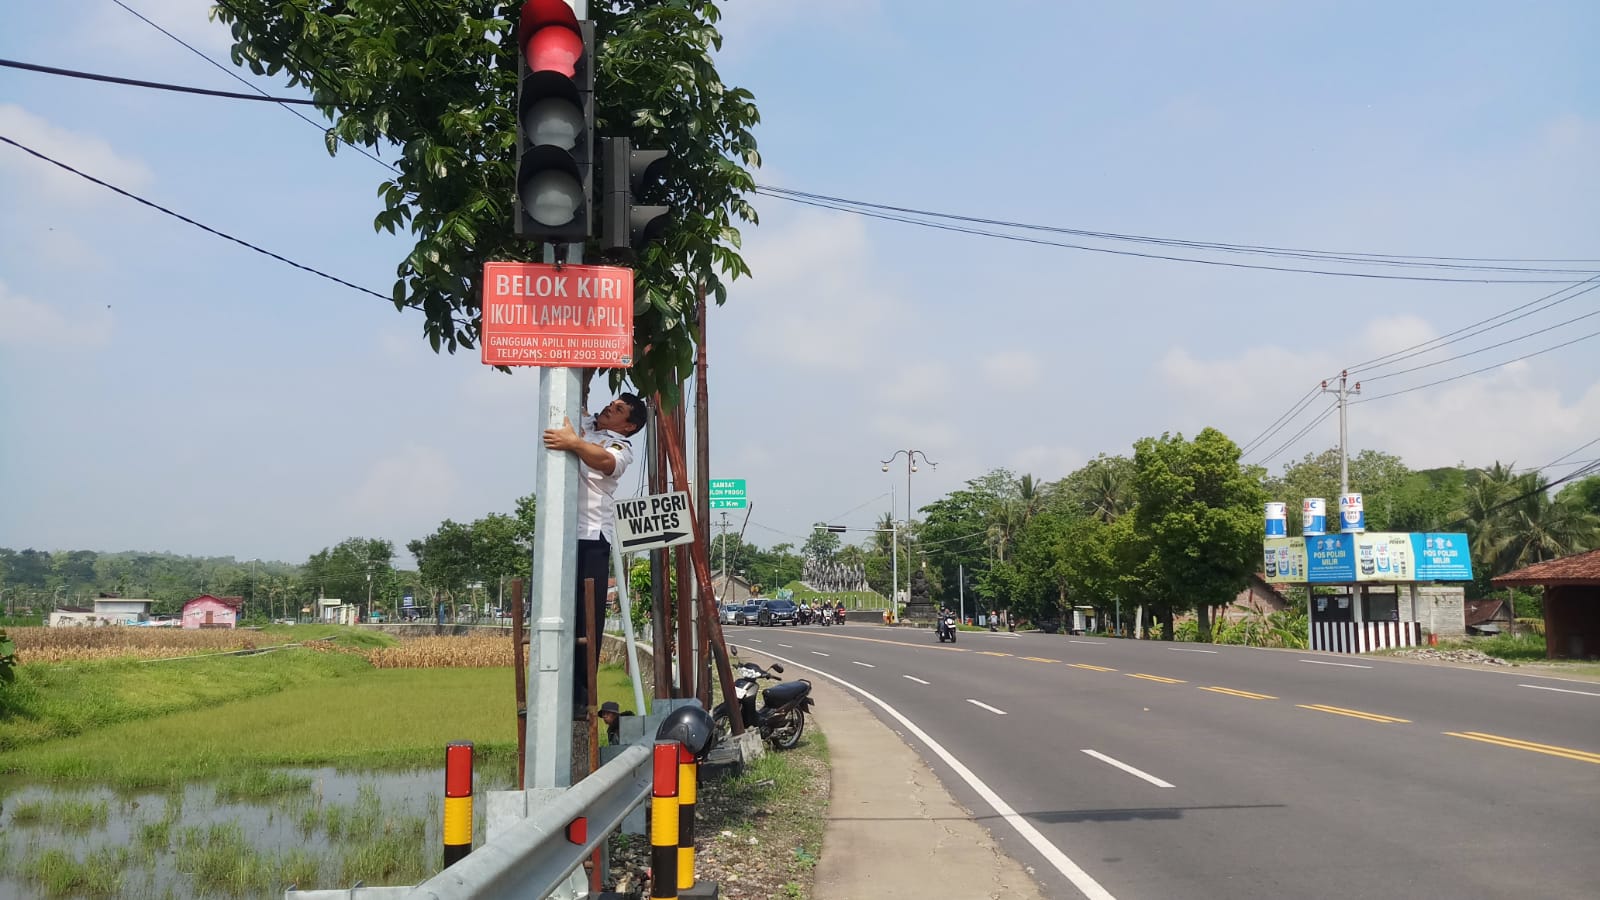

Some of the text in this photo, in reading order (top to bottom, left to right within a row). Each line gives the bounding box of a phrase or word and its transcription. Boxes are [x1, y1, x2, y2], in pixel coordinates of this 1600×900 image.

[496, 274, 621, 299] BELOK KIRI
[491, 303, 625, 328] IKUTI LAMPU APILL
[490, 336, 539, 347] GANGGUAN
[542, 338, 564, 348] APILL
[567, 338, 578, 348] INI
[550, 349, 571, 360] 0811
[574, 350, 596, 360] 2903
[600, 351, 618, 360] 300
[712, 481, 735, 489] SAMSAT
[1341, 496, 1361, 505] ABC
[616, 494, 686, 520] IKIP PGRI
[629, 512, 680, 535] WATES
[1313, 550, 1346, 559] POS POLISI
